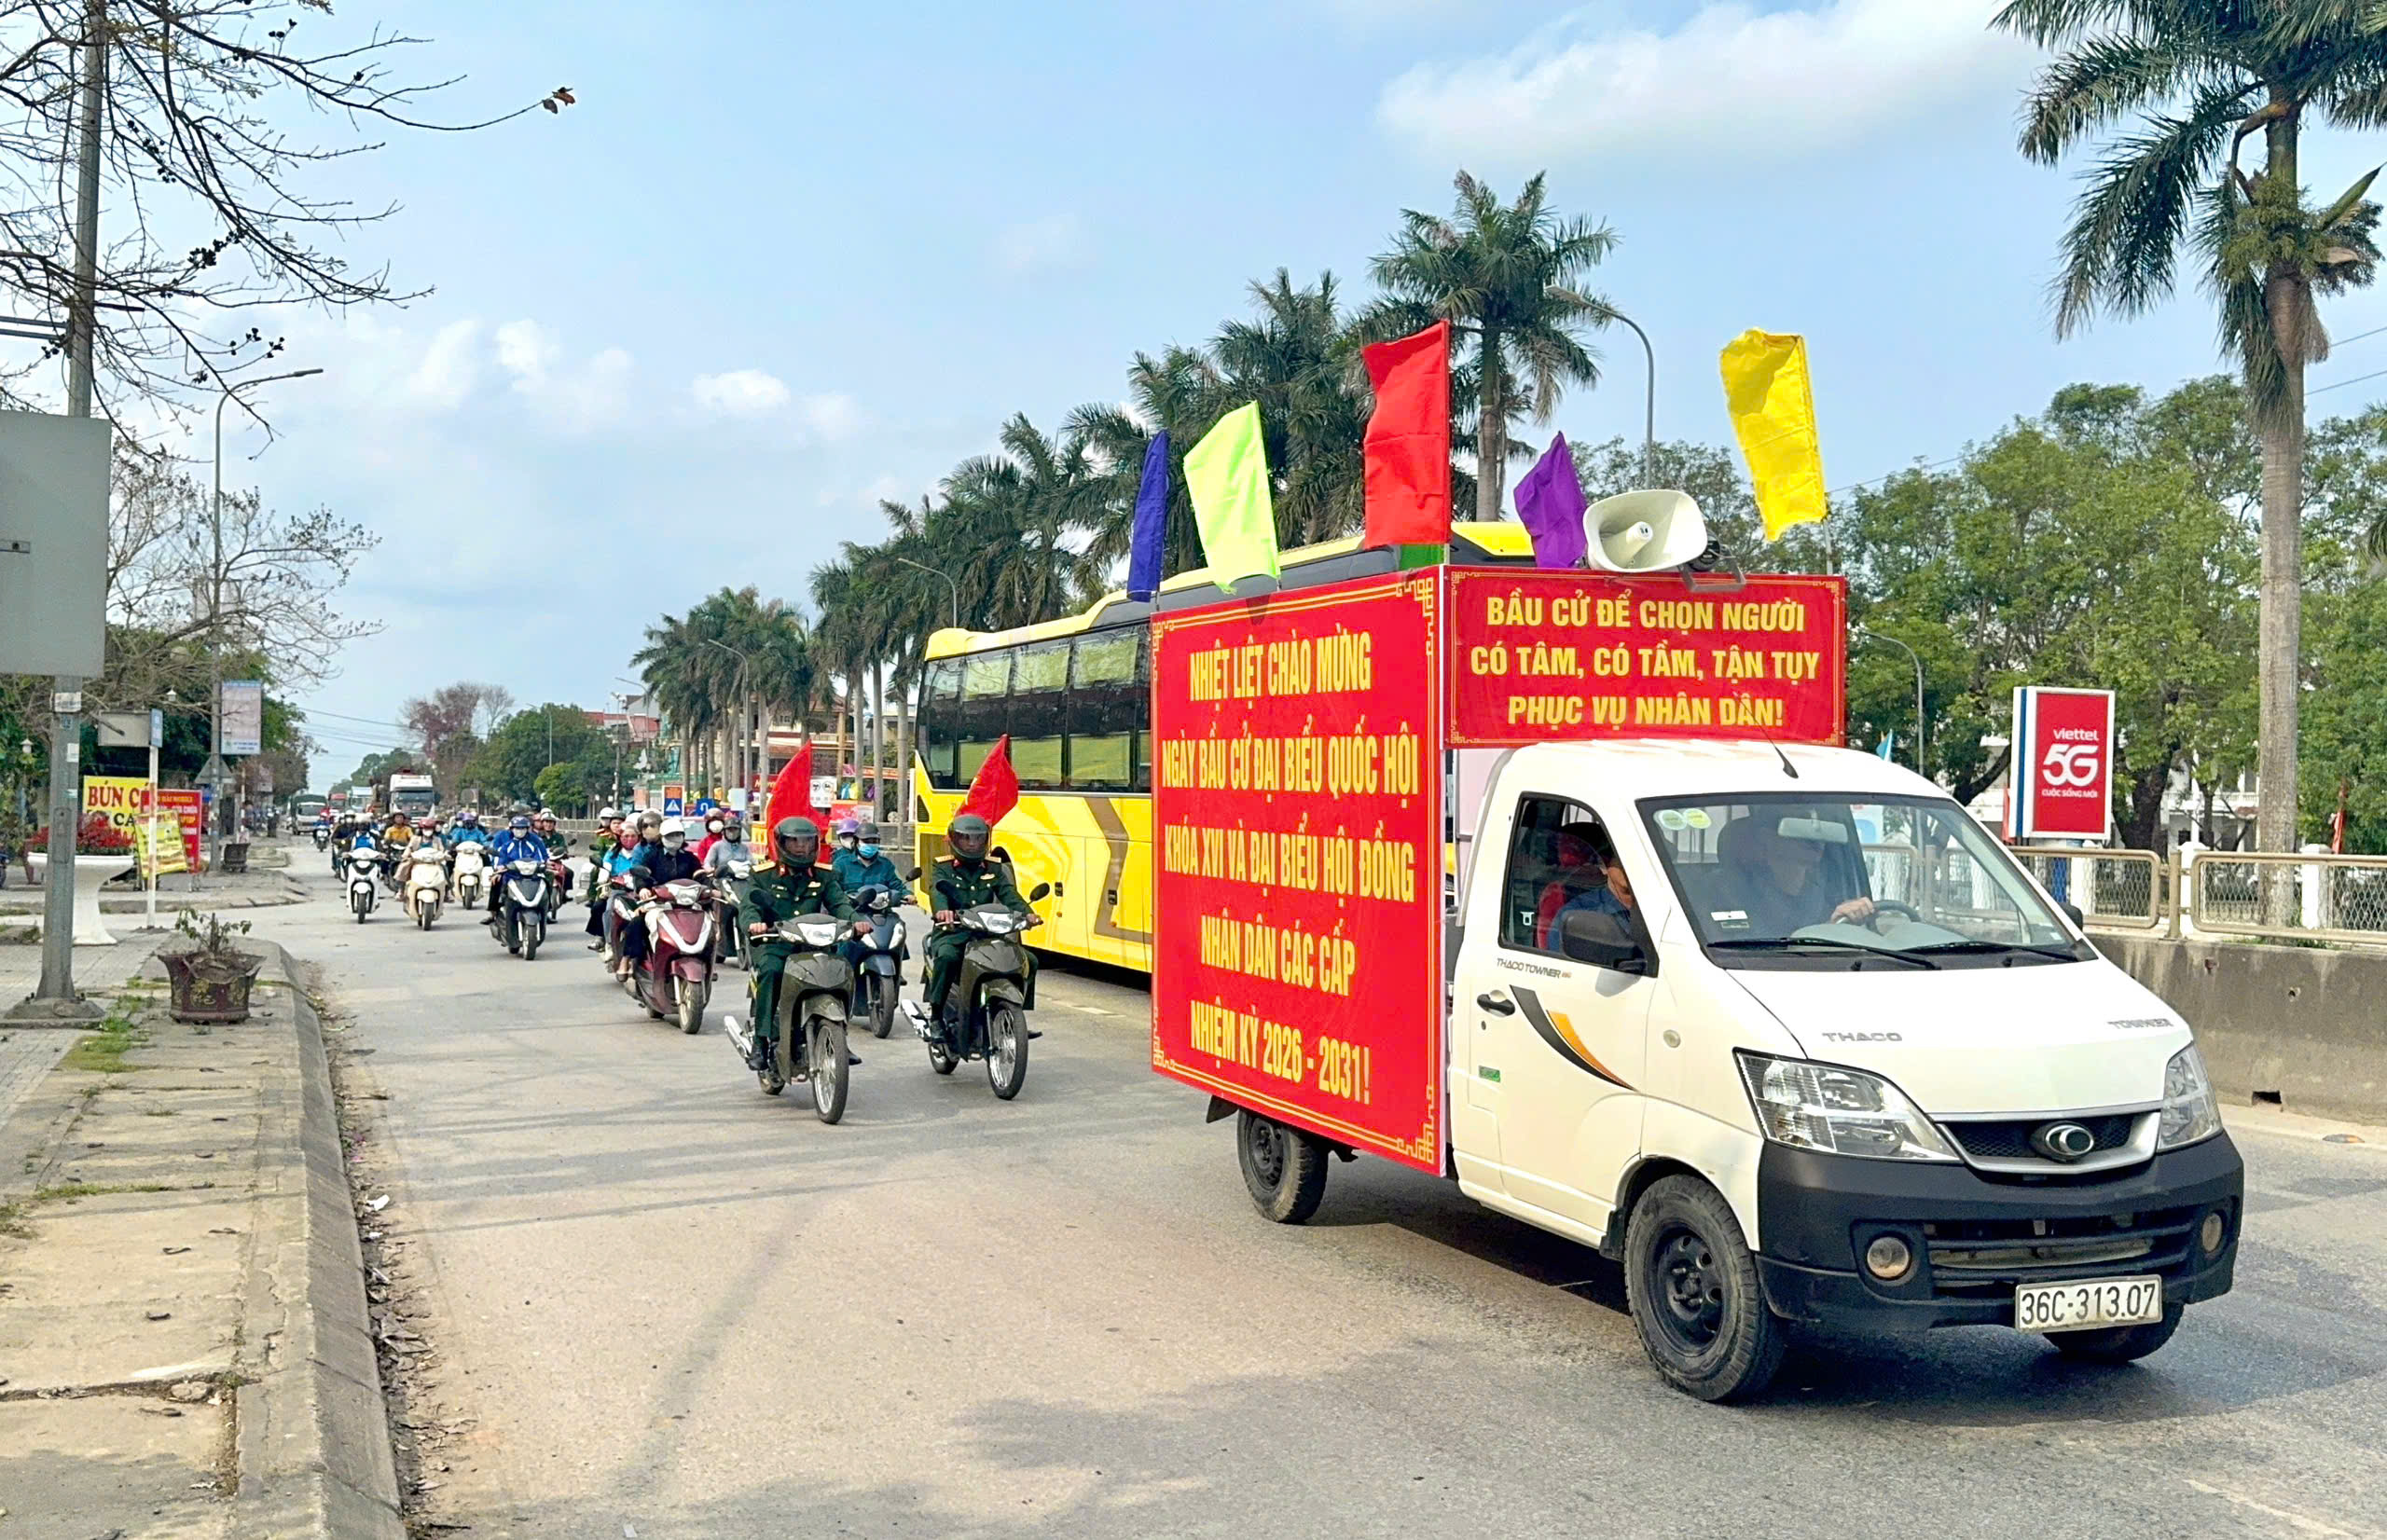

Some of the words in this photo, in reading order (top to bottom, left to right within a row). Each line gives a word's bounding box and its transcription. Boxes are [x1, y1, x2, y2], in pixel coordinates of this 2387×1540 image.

[1487, 587, 1543, 626] BẦU
[1552, 588, 1592, 627] CỬ
[1595, 588, 1632, 627] ĐỂ
[1639, 599, 1714, 636] CHỌN
[1722, 597, 1805, 632] NGƯỜI
[1190, 639, 1231, 711] NHIỆT
[1233, 634, 1264, 709] LIỆT
[1267, 628, 1312, 696] CHÀO
[1316, 622, 1372, 694] MỪNG
[1470, 640, 1508, 676] CÓ
[1515, 640, 1584, 680] TÂM,
[1594, 641, 1630, 677] CÓ
[1637, 639, 1704, 681] TẦM,
[1712, 644, 1764, 684] TẬN
[1771, 651, 1820, 686] TỤY
[1508, 695, 1583, 731] PHỤC
[1592, 695, 1627, 731] VỤ
[1635, 691, 1712, 726] NHÂN
[1718, 692, 1783, 727] DÂN!
[2053, 727, 2099, 741] viettel
[1162, 729, 1196, 789] NGÀY
[1198, 721, 1227, 791] BẦU
[1230, 720, 1252, 791] CỬ
[1253, 737, 1280, 803] ĐẠI
[1284, 713, 1323, 793] BIỂU
[1327, 714, 1378, 800] QUỐC
[1384, 721, 1418, 809] HỘI
[2042, 743, 2099, 787] 5G
[87, 780, 124, 807] BÚN
[1165, 815, 1199, 875] KHÓA
[1201, 827, 1224, 879] XVI
[1226, 818, 1247, 882] VÀ
[1249, 831, 1276, 897] ĐẠI
[1280, 812, 1318, 891] BIỂU
[1322, 825, 1354, 908] HỘI
[1358, 819, 1414, 903] ĐỒNG
[1201, 907, 1241, 972] NHÂN
[1244, 913, 1276, 981] DÂN
[1280, 919, 1315, 989] CÁC
[1318, 918, 1356, 997] CẤP
[1497, 957, 1525, 971] THACO
[1525, 963, 1562, 979] TOWNER
[1821, 1032, 1903, 1042] THACO
[2107, 1018, 2173, 1029] TOWNER
[1191, 996, 1236, 1069] NHIỆM
[1239, 1005, 1260, 1069] KỲ
[1262, 1021, 1303, 1083] 2026
[1318, 1036, 1370, 1105] 2031!
[2021, 1283, 2156, 1325] 36C-313.07
